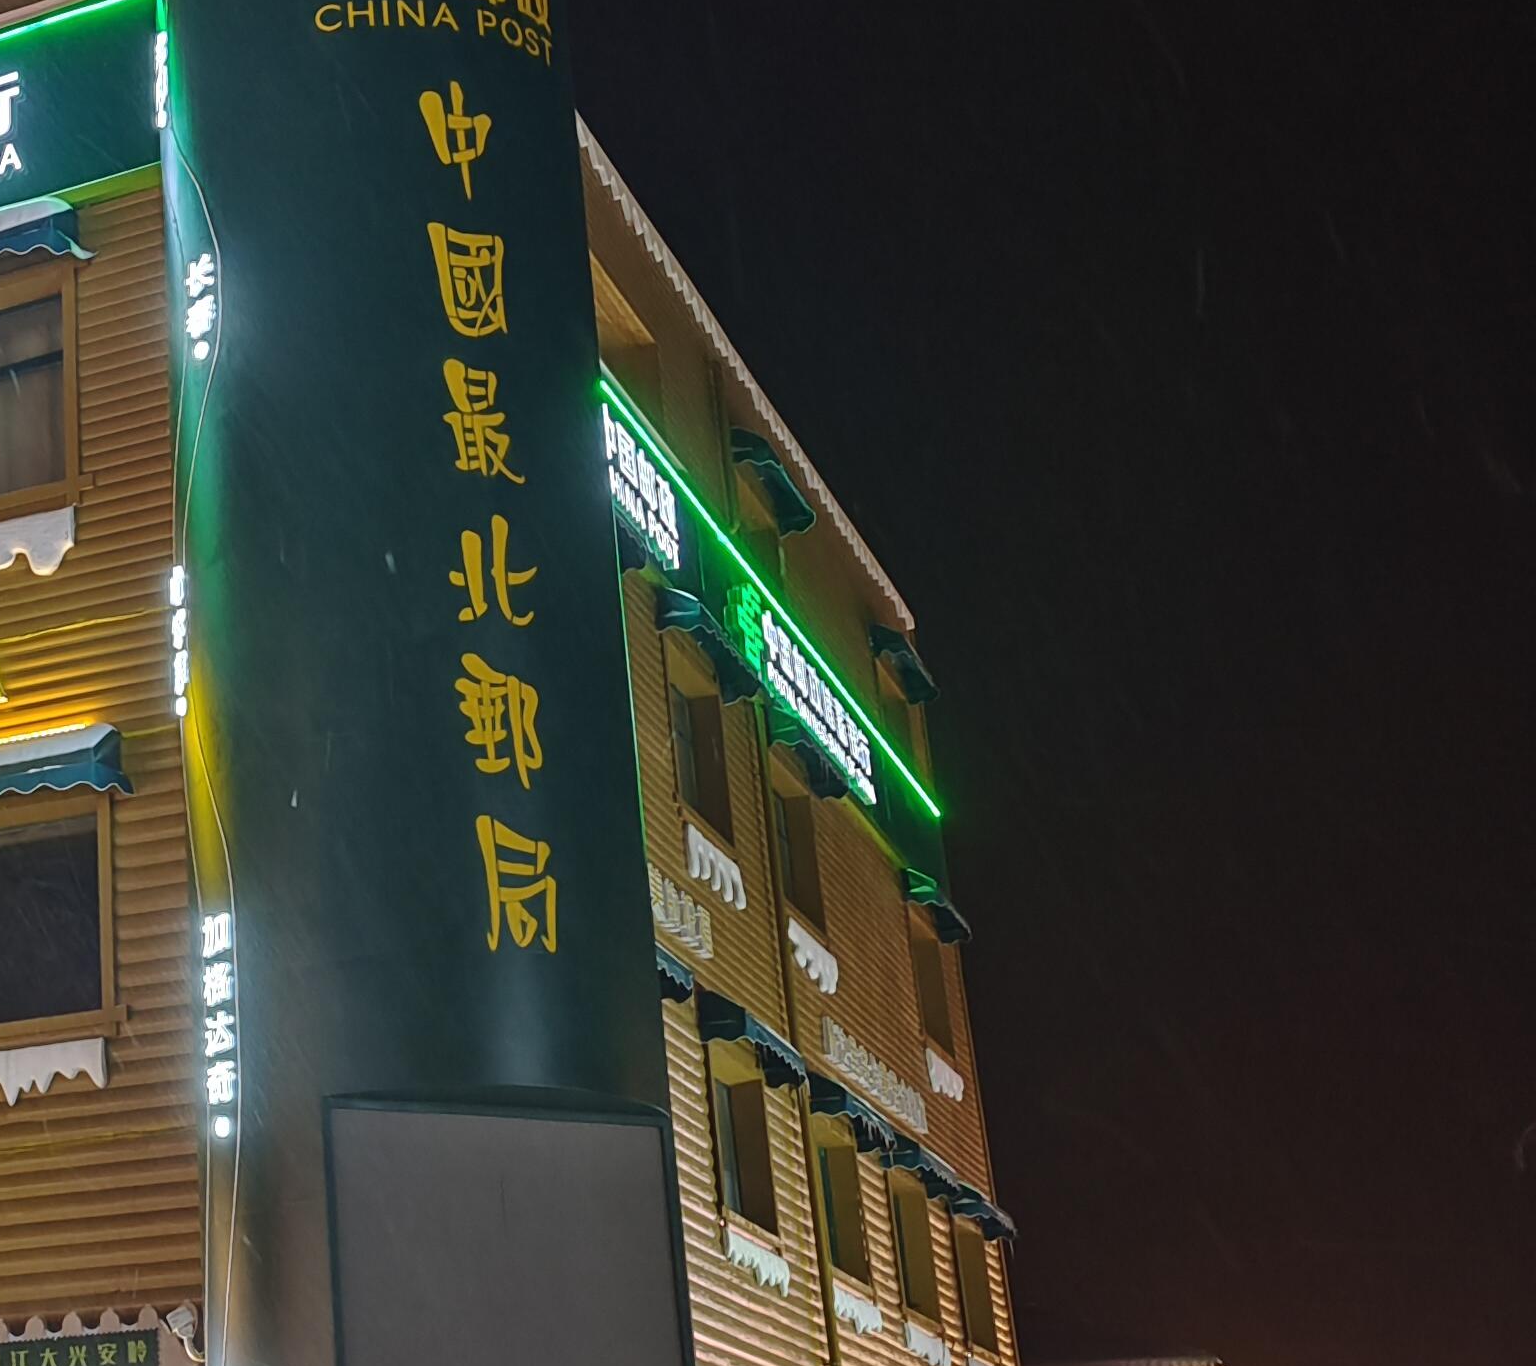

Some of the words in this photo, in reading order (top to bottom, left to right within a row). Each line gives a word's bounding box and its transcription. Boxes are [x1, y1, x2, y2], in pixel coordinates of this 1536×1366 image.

[313, 0, 461, 34] CHINA
[478, 11, 553, 67] POST
[608, 465, 647, 530] HINA
